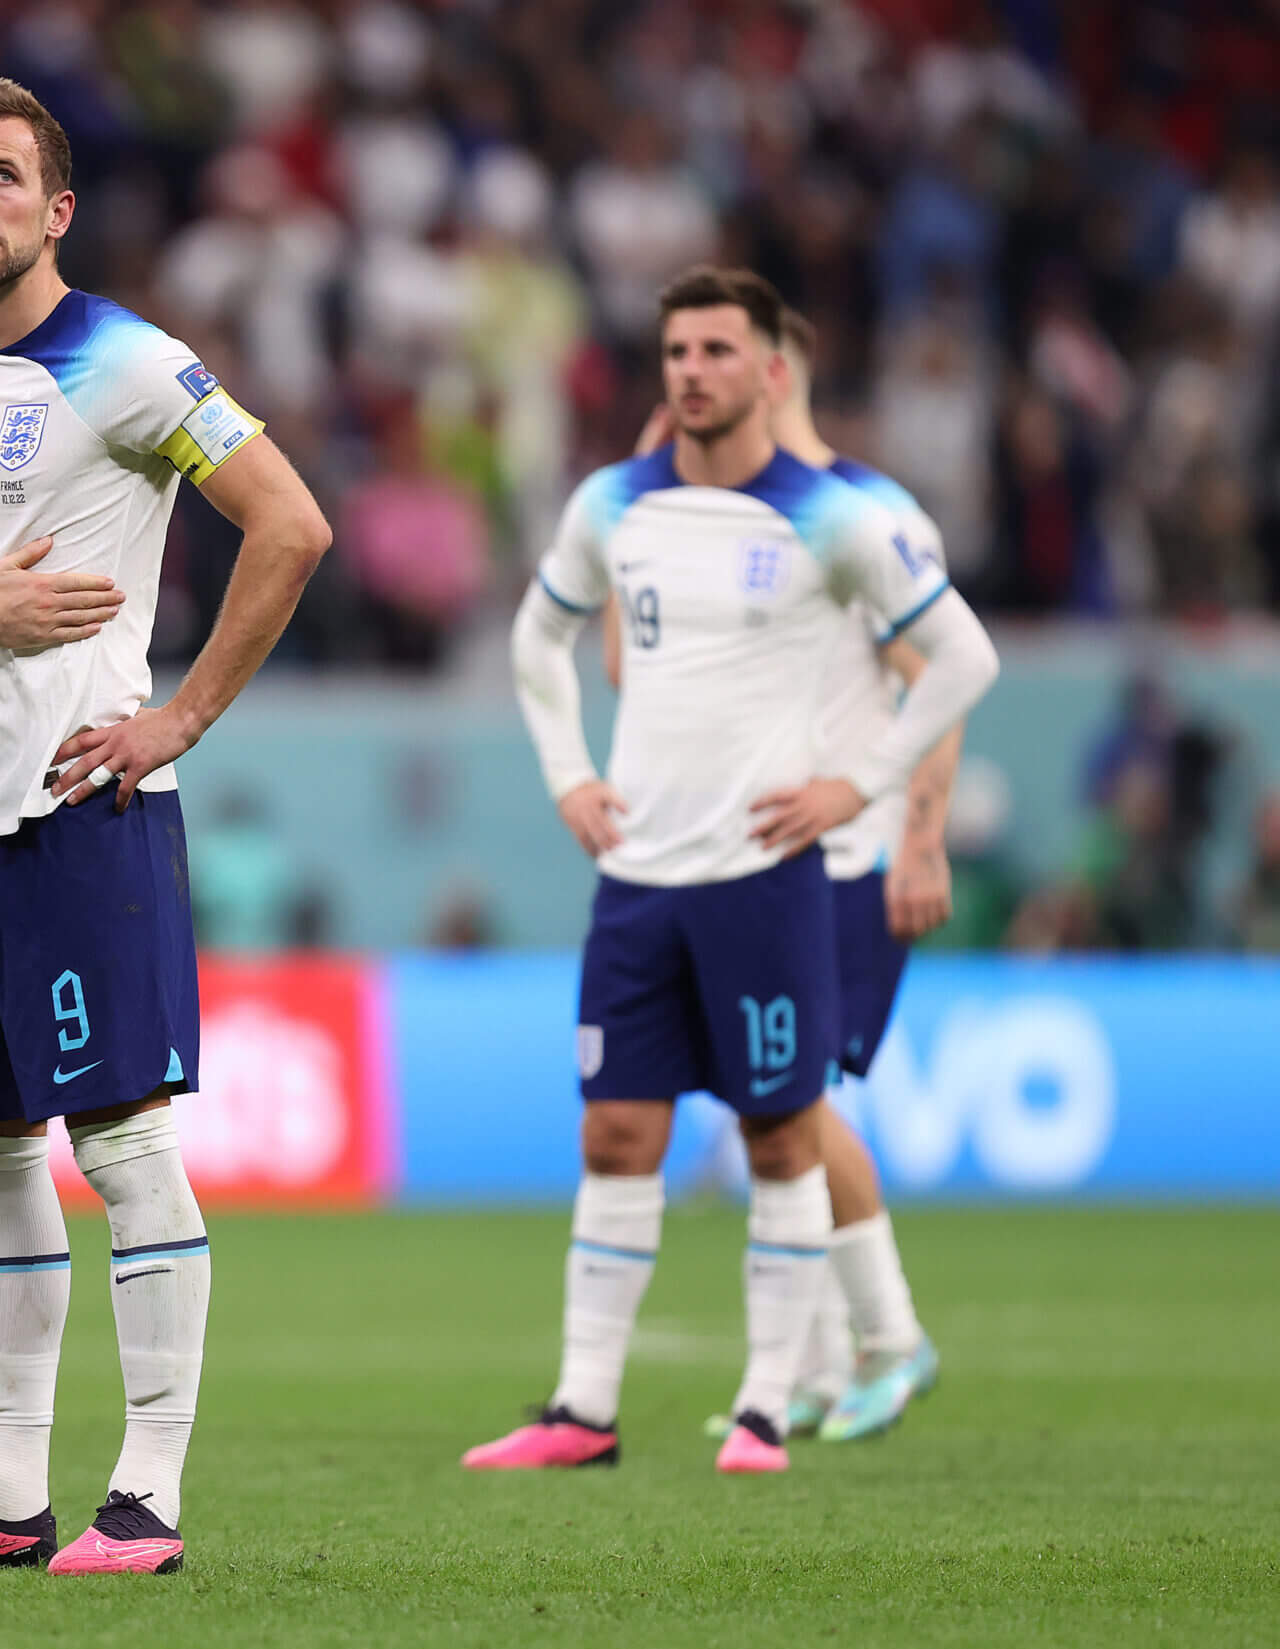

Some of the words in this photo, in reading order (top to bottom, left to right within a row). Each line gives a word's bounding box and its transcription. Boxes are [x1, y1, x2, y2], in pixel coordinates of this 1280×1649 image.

[0, 480, 24, 491] FRANCE
[618, 584, 661, 650] 19
[51, 969, 91, 1052] 9
[739, 994, 797, 1069] 19
